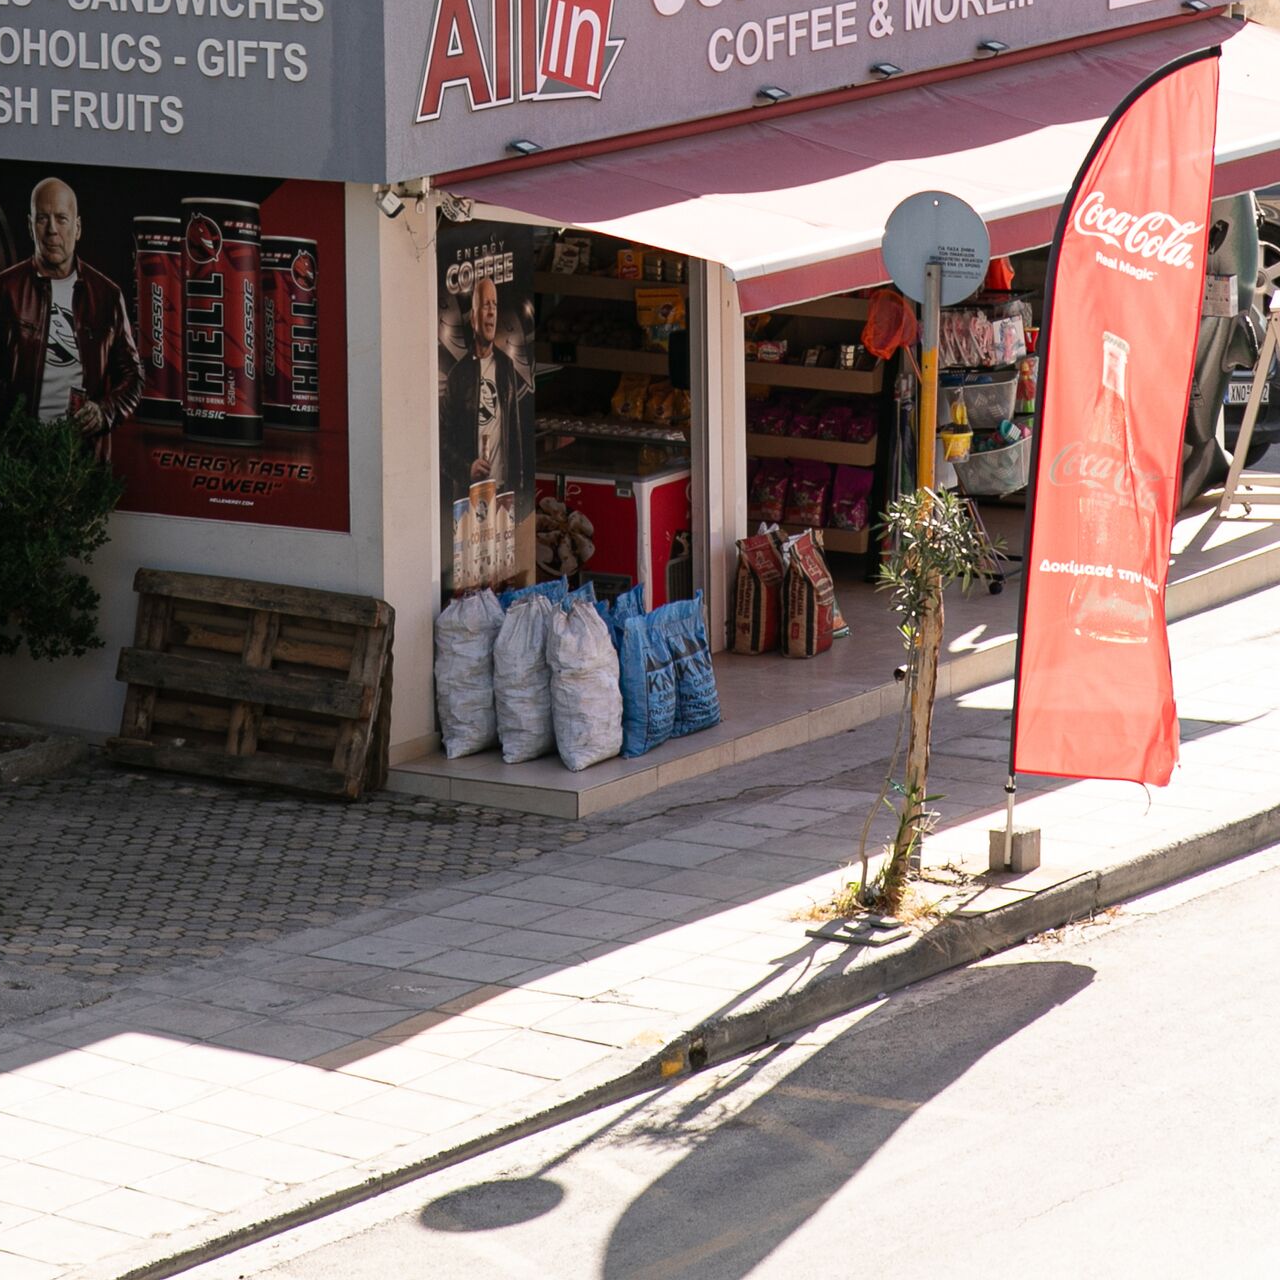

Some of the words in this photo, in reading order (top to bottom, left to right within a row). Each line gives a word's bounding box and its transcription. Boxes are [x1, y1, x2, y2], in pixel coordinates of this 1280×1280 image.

[708, 1, 857, 72] COFFEE
[198, 38, 308, 82] GIFTS
[51, 88, 184, 134] FRUITS
[457, 241, 504, 261] ENERGY
[1074, 191, 1204, 267] Coca-Cola
[446, 252, 513, 294] COFFEE
[1096, 251, 1117, 269] Real
[152, 282, 164, 369] CLASSIC
[186, 273, 224, 395] HELL
[245, 279, 255, 380] CLASSIC
[292, 297, 317, 394] HELL
[186, 408, 225, 419] CLASSIC
[206, 397, 224, 405] DRINK
[249, 460, 317, 482] TASTE,
[1039, 559, 1114, 578] Δοκίμασέ
[1117, 569, 1142, 584] την
